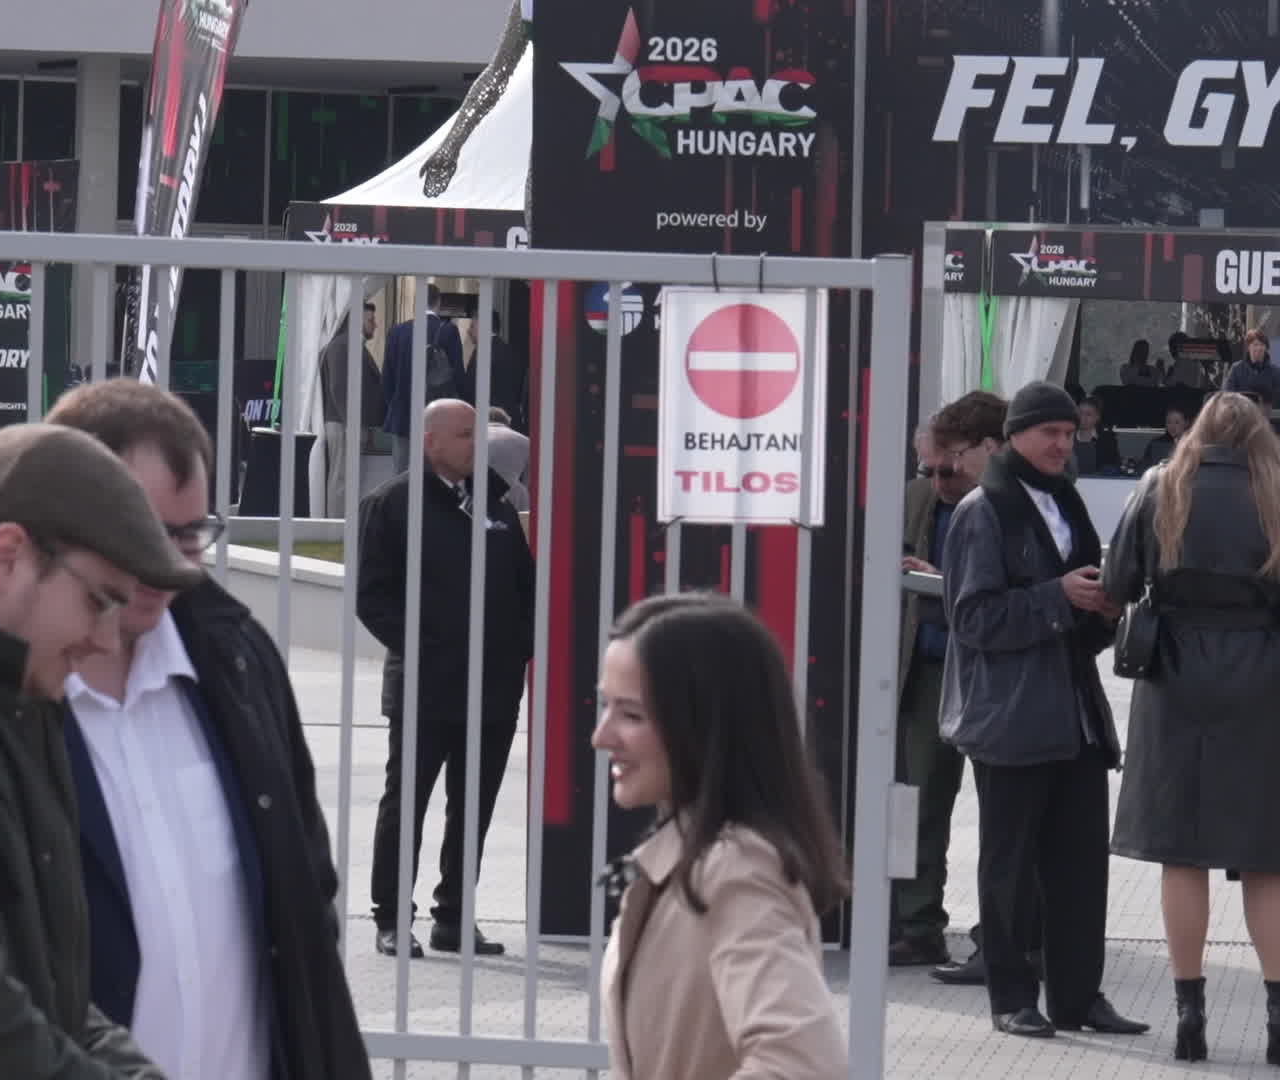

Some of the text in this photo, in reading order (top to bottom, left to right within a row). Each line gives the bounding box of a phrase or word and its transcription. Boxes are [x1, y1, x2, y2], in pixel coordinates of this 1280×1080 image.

[648, 37, 718, 62] 2026
[622, 66, 817, 126] CPAC
[931, 55, 1136, 150] FEL,
[677, 130, 816, 157] HUNGARY
[656, 210, 767, 232] powered by
[1049, 277, 1096, 287] HUNGARY
[674, 471, 801, 494] TILOS
